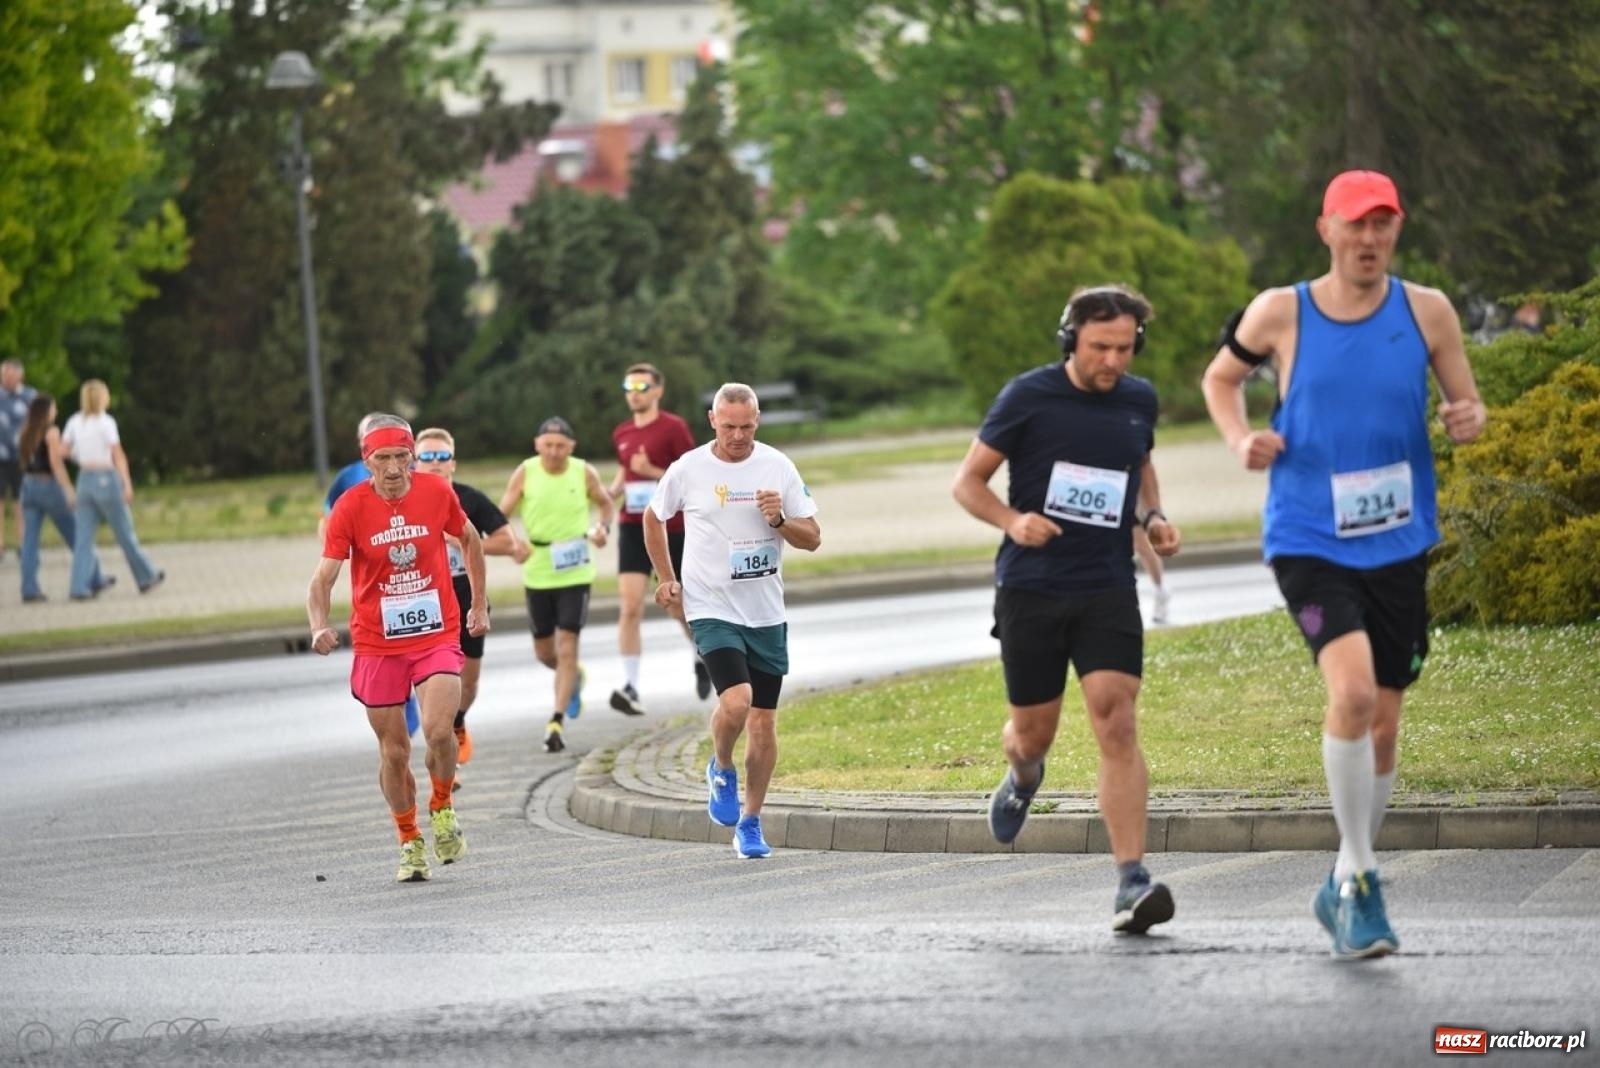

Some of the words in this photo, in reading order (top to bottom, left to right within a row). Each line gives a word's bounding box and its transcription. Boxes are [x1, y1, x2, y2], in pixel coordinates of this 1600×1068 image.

[1067, 487, 1107, 510] 206
[1355, 491, 1395, 516] 234
[390, 515, 405, 528] OD
[370, 525, 430, 546] URODZENIA
[744, 554, 769, 570] 184
[389, 570, 421, 584] DUMNI
[398, 609, 427, 626] 168
